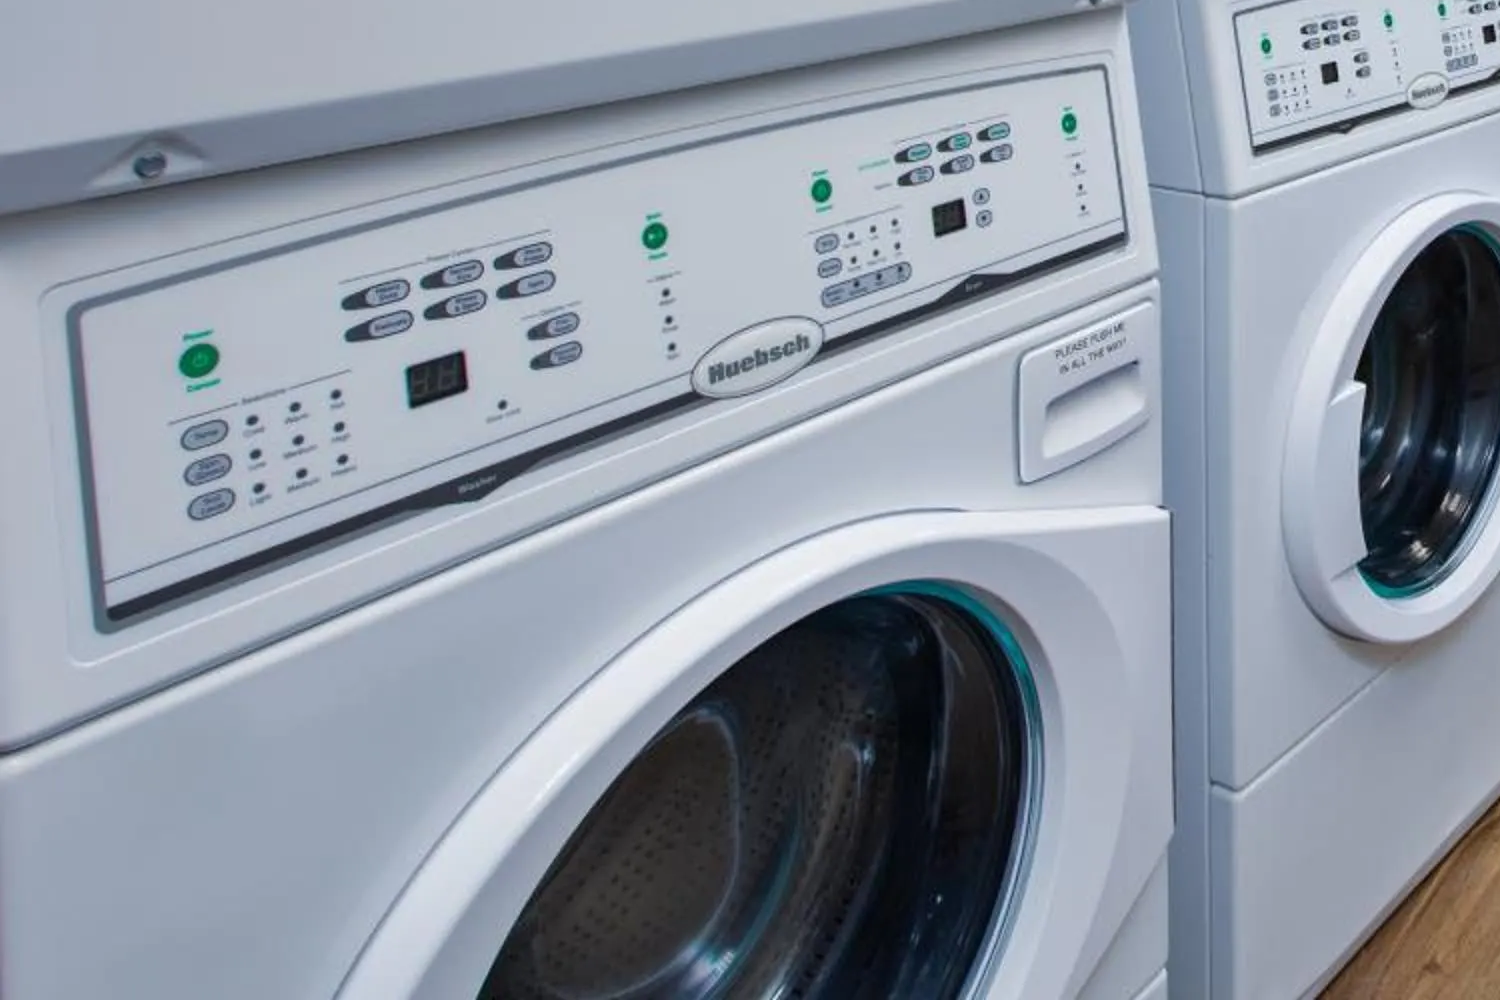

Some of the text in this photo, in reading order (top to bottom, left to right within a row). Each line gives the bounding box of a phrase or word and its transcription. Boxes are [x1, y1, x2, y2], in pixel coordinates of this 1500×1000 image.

[707, 334, 811, 385] Huebsch
[1055, 337, 1089, 360] PLEASE
[1088, 347, 1105, 362] THE
